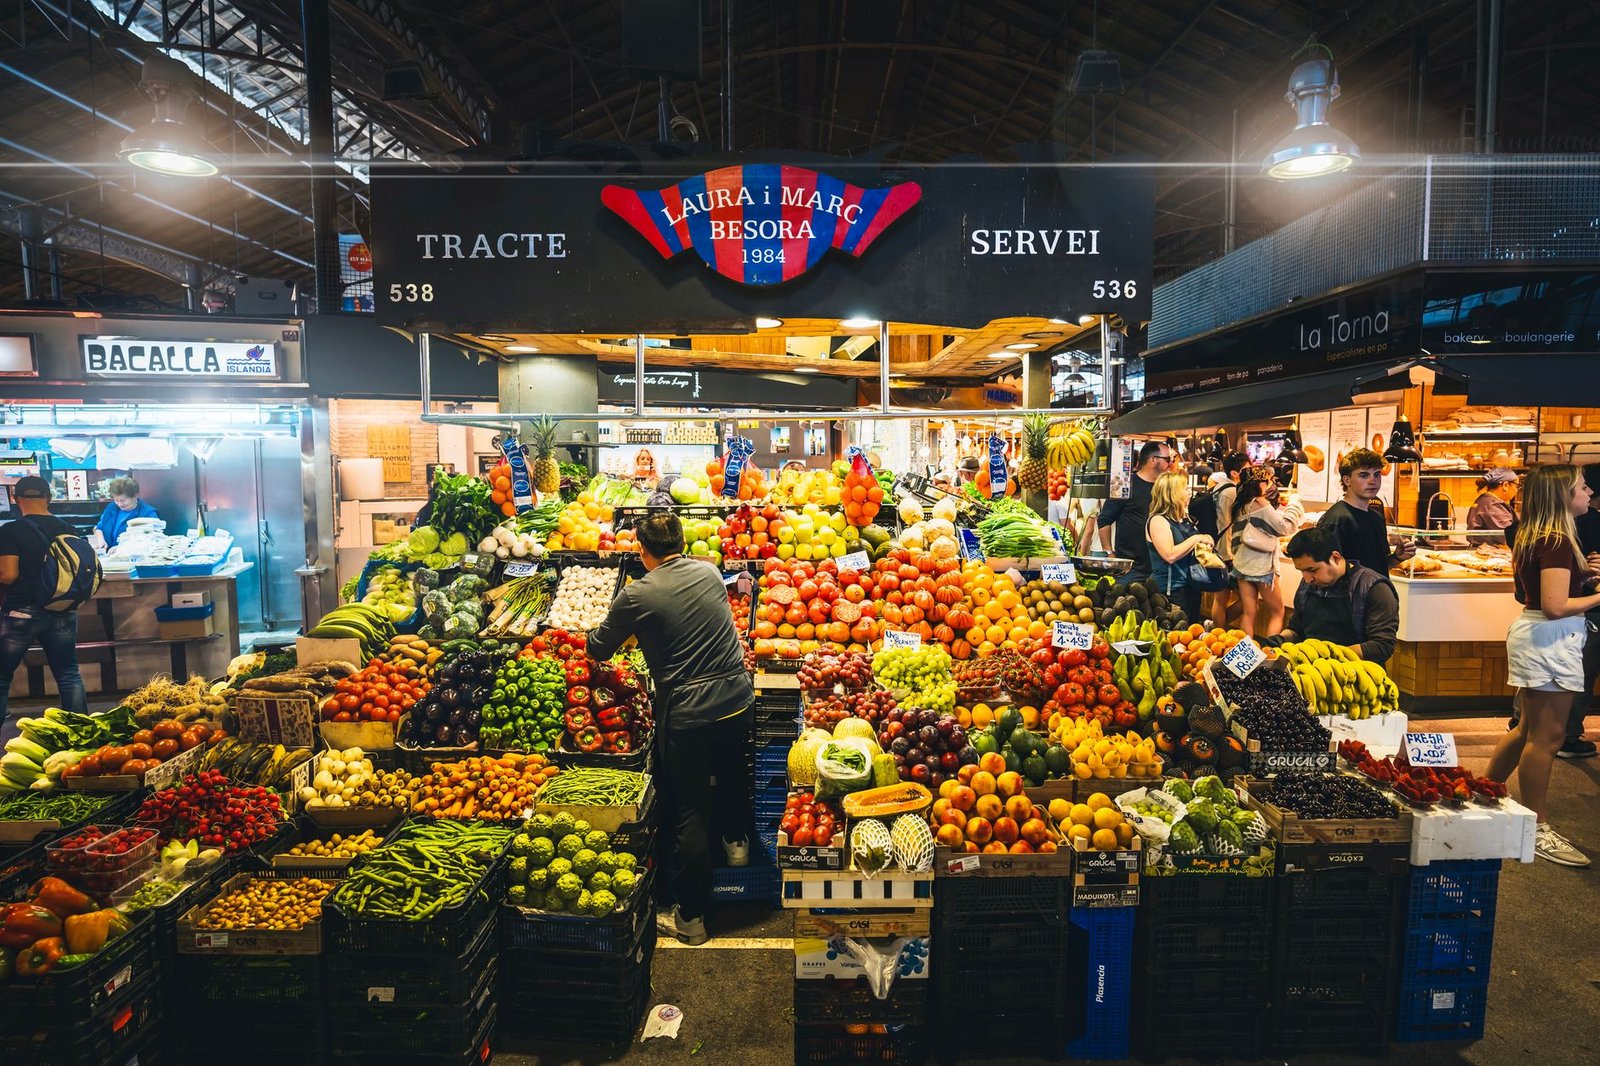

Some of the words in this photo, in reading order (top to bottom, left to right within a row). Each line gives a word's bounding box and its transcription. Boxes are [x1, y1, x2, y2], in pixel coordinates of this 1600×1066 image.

[661, 186, 755, 227] LAURA
[763, 185, 771, 205] i
[780, 186, 863, 225] MARC
[709, 220, 816, 240] BESORA
[416, 233, 567, 259] TRACTE
[971, 229, 1100, 255] SERVEI
[742, 249, 786, 264] 1984
[389, 283, 434, 302] 538
[1092, 280, 1137, 299] 536
[1300, 323, 1321, 350] La
[1328, 310, 1389, 345] Torna
[1444, 331, 1485, 345] bakery
[1505, 331, 1575, 345] boulangerie
[226, 365, 272, 373] ISLANDIA
[1221, 641, 1248, 666] CEREZA
[1406, 733, 1445, 744] FRESA
[1267, 756, 1316, 767] GRUCAL
[789, 855, 818, 863] GRUCAL
[849, 920, 870, 929] CASI
[1095, 964, 1105, 1003] Plasencia
